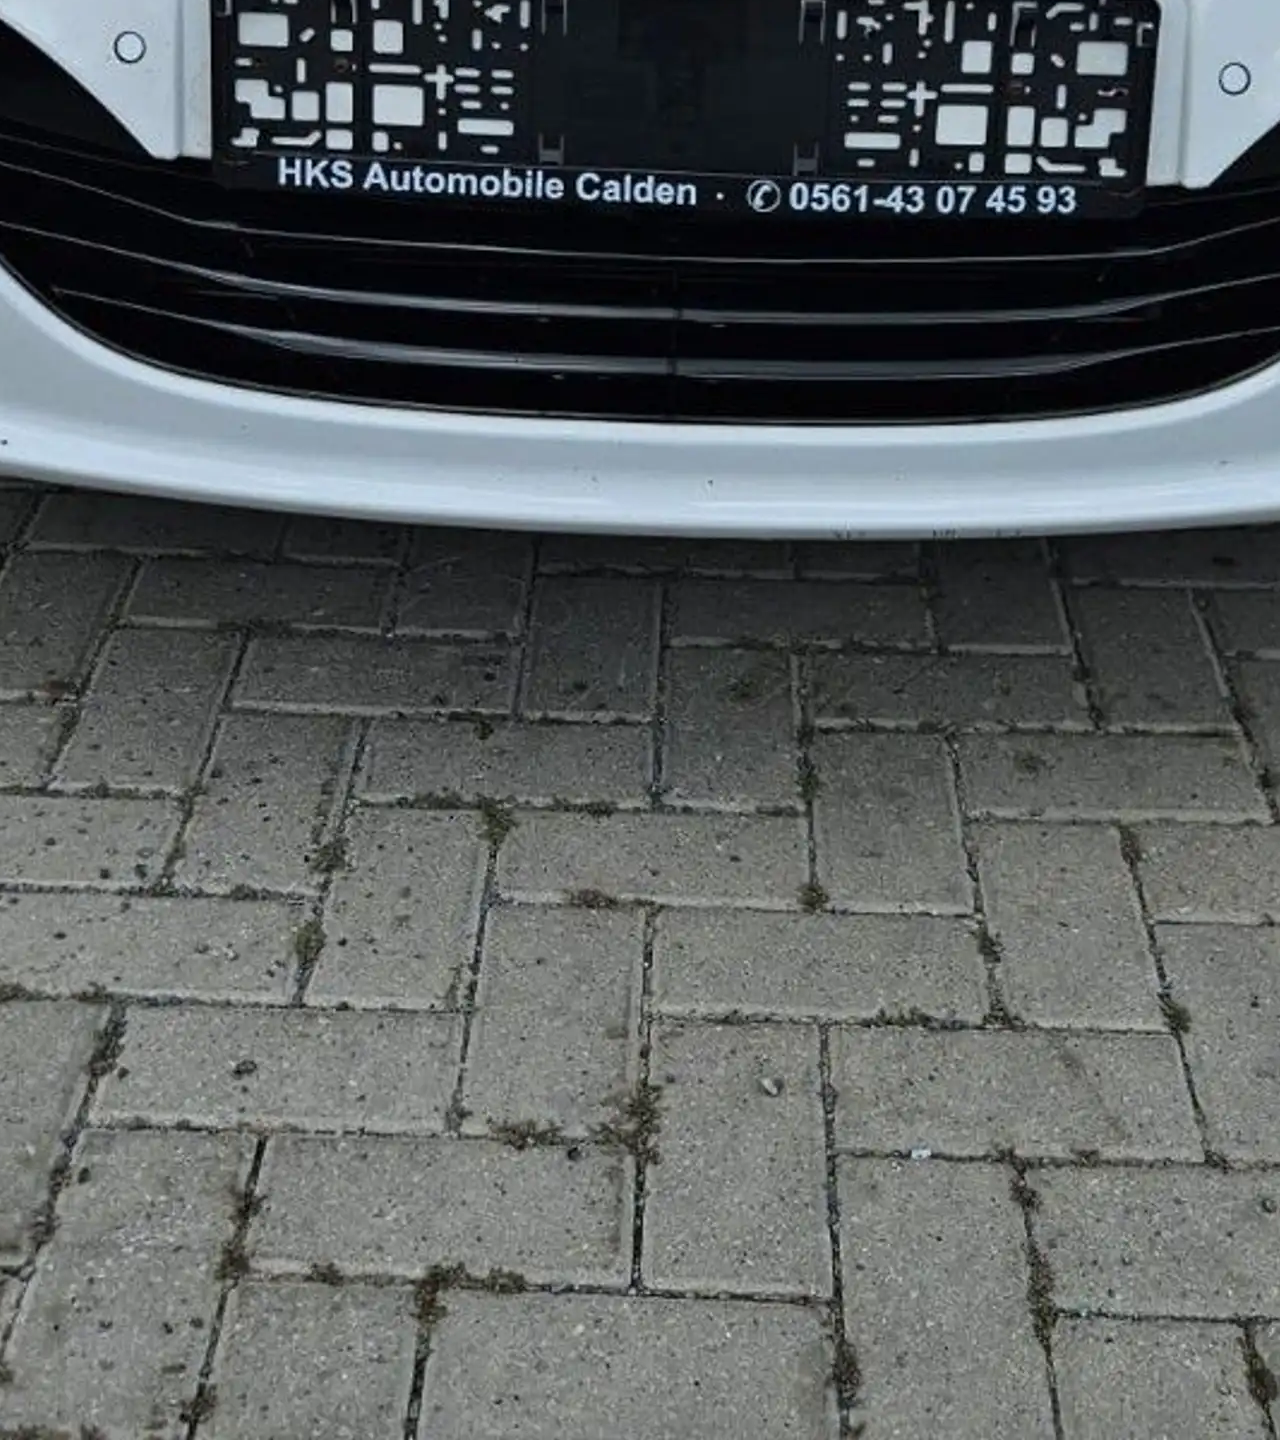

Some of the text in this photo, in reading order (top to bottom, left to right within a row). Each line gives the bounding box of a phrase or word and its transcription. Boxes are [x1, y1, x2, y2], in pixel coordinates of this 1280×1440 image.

[278, 157, 1077, 215] HKS Automobile Calden 0561-43 07 45 93
